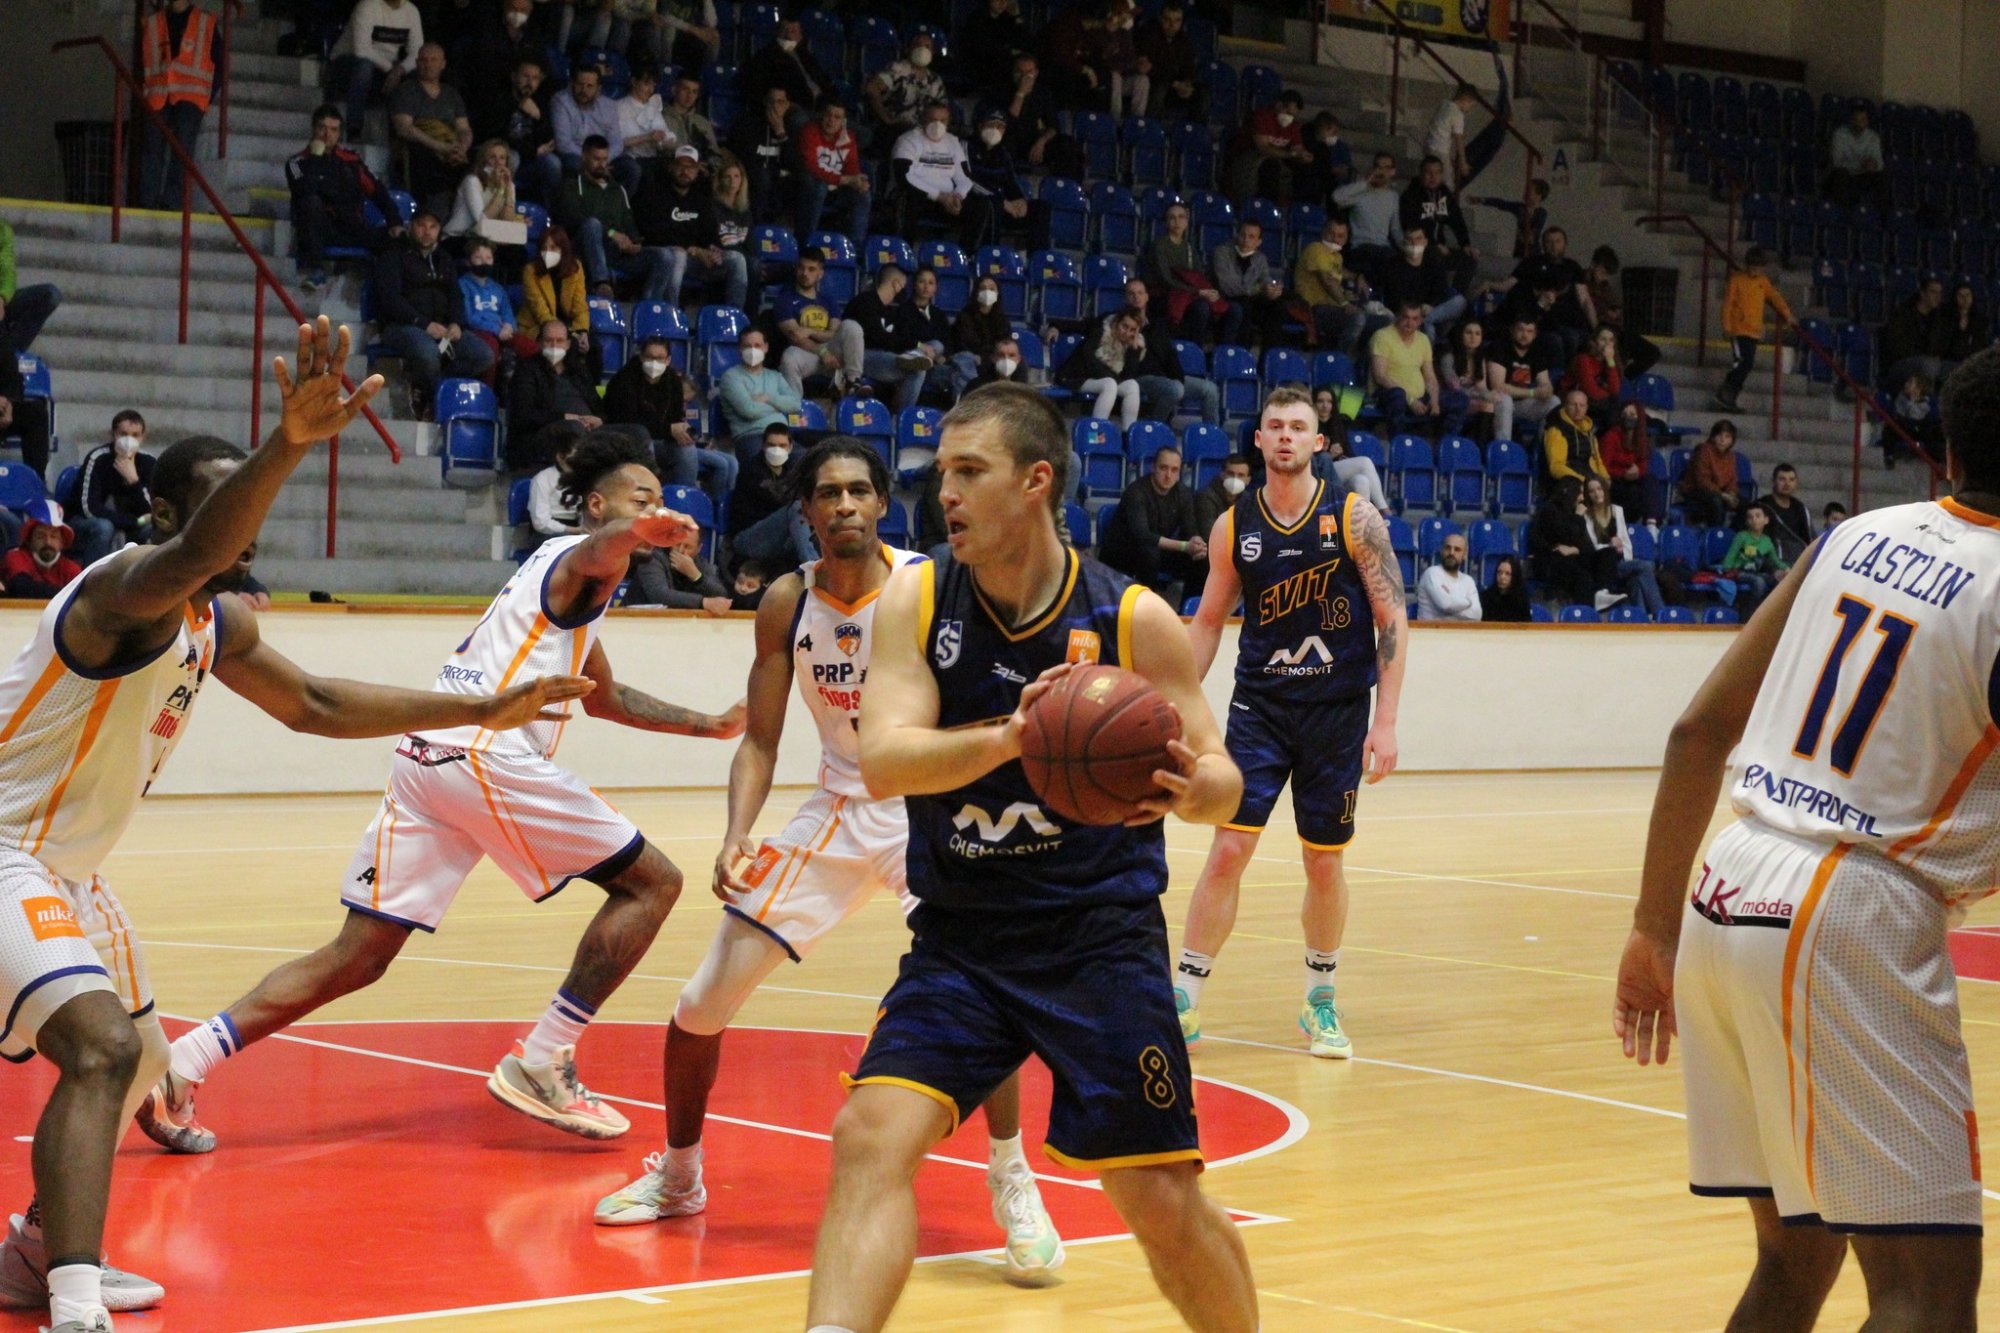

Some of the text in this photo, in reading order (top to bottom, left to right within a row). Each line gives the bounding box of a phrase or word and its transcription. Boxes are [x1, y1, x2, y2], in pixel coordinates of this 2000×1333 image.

[1552, 149, 1568, 171] A
[1840, 532, 1975, 610] CASTLIN
[1260, 558, 1340, 626] SVIT
[1319, 597, 1351, 630] 18
[812, 662, 854, 683] PRP
[1263, 663, 1334, 676] CHEMOSVIT
[1791, 592, 1919, 779] 11
[1740, 897, 1793, 917] móda
[1139, 1046, 1176, 1108] 8
